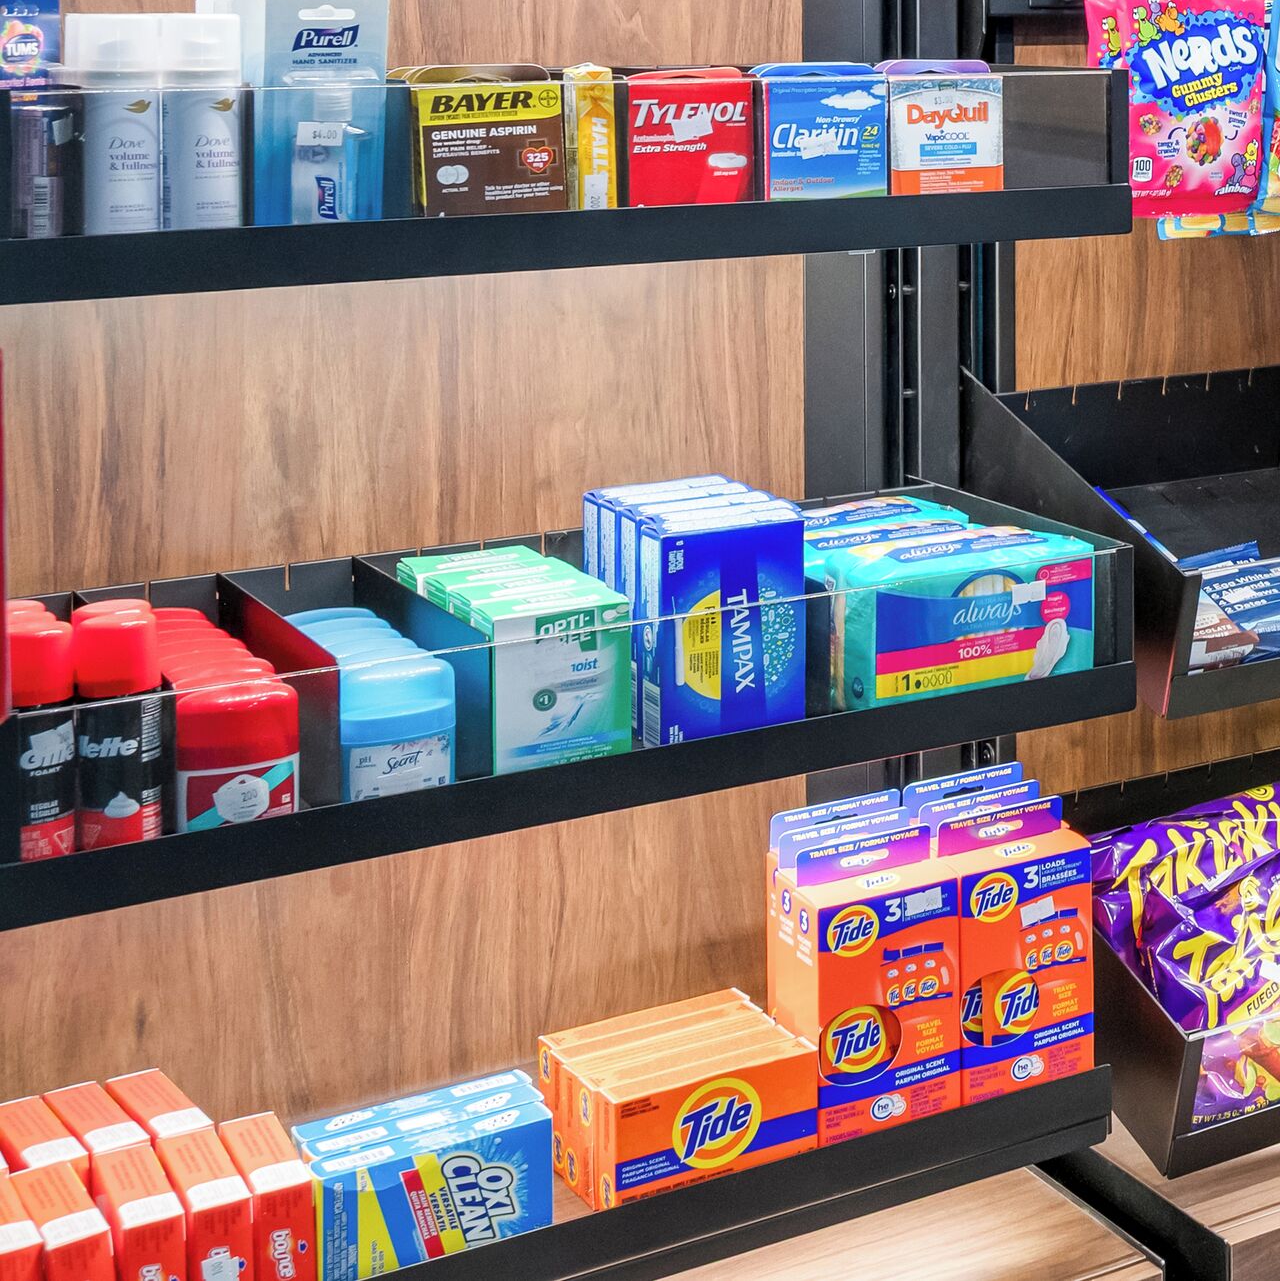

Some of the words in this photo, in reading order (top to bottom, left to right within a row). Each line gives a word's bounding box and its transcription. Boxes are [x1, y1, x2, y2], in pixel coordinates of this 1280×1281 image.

[301, 30, 353, 46] Purell
[6, 42, 38, 56] TUMS
[1172, 73, 1223, 99] Gummy
[1185, 81, 1238, 107] Clusters
[431, 91, 532, 114] BAYER
[632, 99, 746, 128] TYLENOL
[816, 115, 860, 124] Non-Drowsy
[907, 102, 988, 129] DayQuil
[195, 135, 230, 146] Dove
[432, 128, 486, 140] GENUINE
[490, 125, 536, 137] ASPIRIN
[864, 126, 878, 135] 24
[925, 132, 968, 143] VapoCOOL
[109, 137, 145, 149] Dove
[634, 145, 661, 153] Extra
[664, 143, 706, 152] Strength
[110, 152, 150, 160] volume
[527, 153, 548, 162] 325
[1135, 160, 1150, 171] 100
[953, 598, 1021, 627] always
[727, 589, 755, 693] TAMPAX
[959, 645, 991, 659] 100%
[30, 767, 61, 777] FOAMY
[382, 751, 423, 774] Secret
[31, 800, 58, 810] REGULAR
[1042, 859, 1065, 869] LOADS
[1042, 869, 1077, 883] BRASSÉES
[884, 898, 901, 922] 3
[832, 915, 873, 953] Tide
[1247, 981, 1279, 1016] FUEGO
[832, 1018, 881, 1066] Tide
[1034, 1037, 1057, 1047] PARFUM
[1058, 1027, 1084, 1040] ORIGINAL
[680, 1095, 752, 1163] Tide
[442, 1155, 495, 1243] CLEAN
[477, 1167, 516, 1217] OXI
[429, 1192, 445, 1233] VERSATIL
[439, 1186, 458, 1231] VERSATILE
[271, 1229, 295, 1279] bounce
